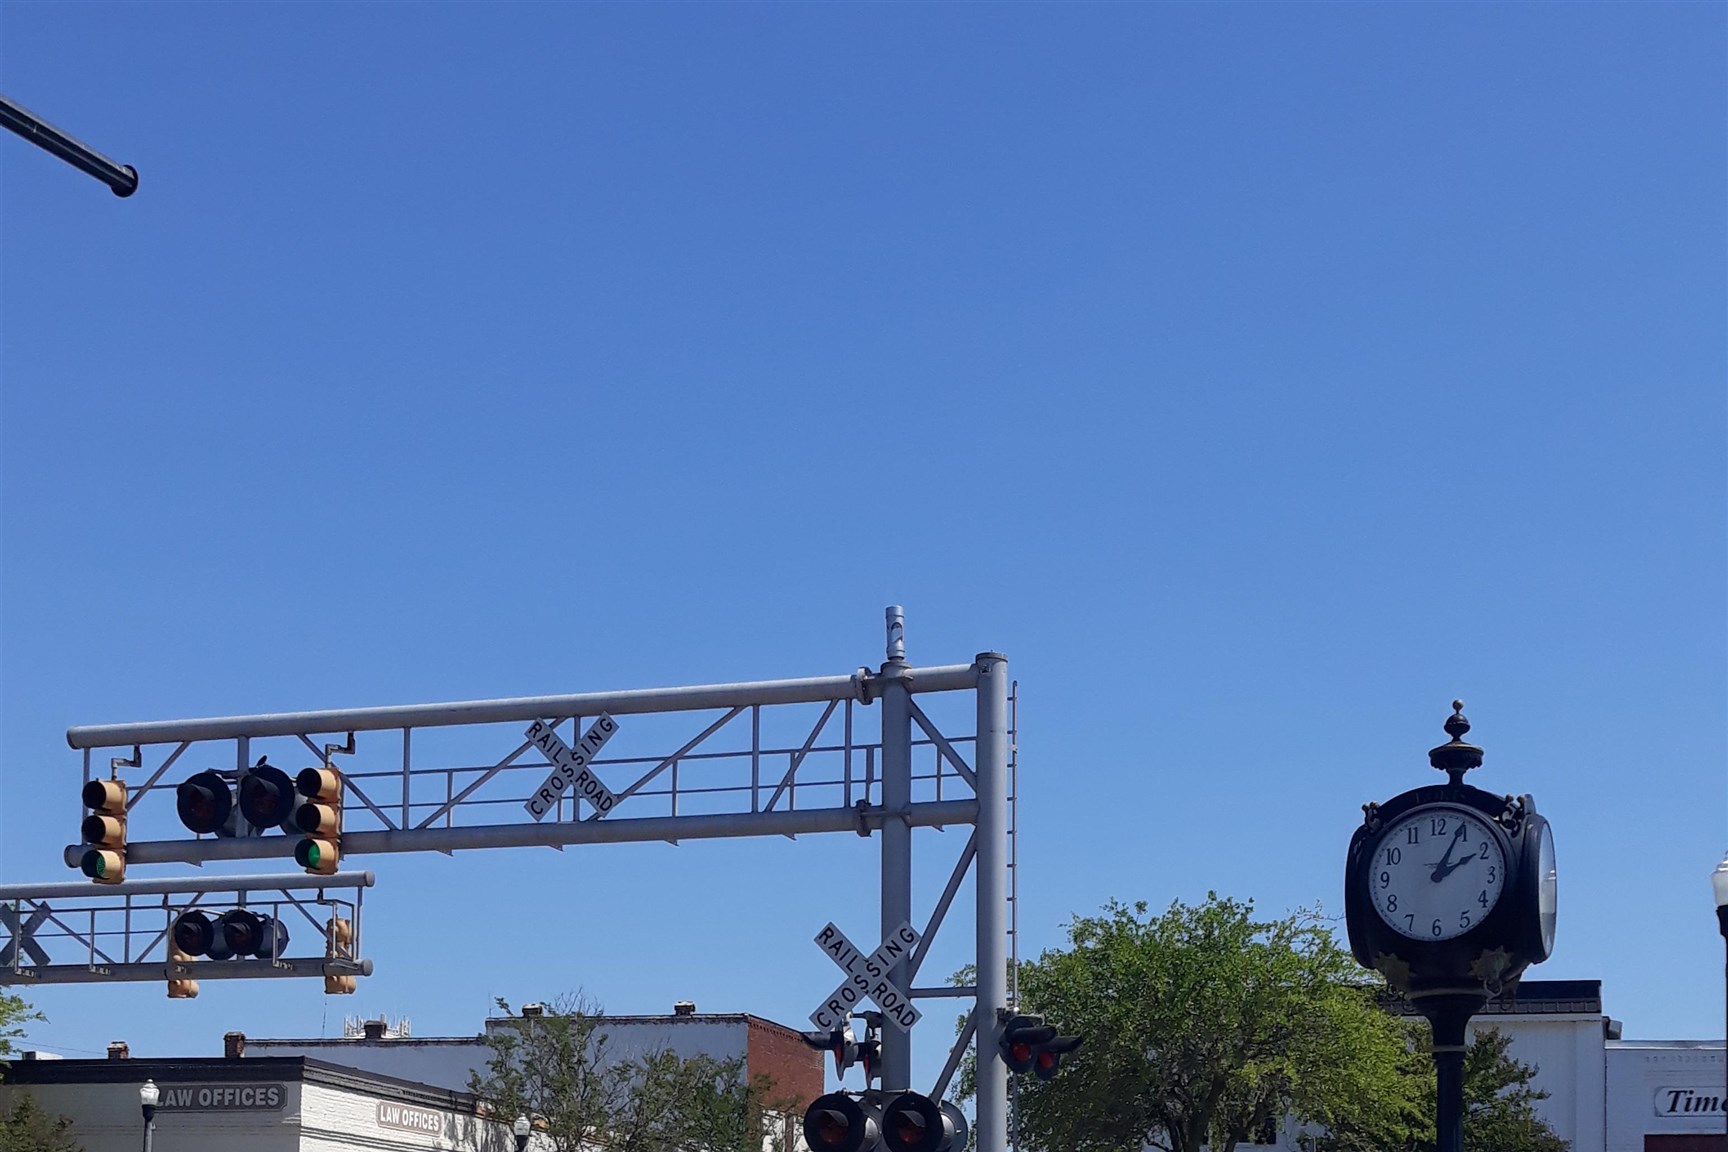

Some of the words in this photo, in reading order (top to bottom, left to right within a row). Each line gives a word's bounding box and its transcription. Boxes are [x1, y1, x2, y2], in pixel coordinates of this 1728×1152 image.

[530, 718, 613, 815] CROSSING
[1406, 827, 1420, 844] 11
[1430, 818, 1447, 836] 12
[1385, 847, 1401, 866] 10
[1479, 842, 1489, 860] 2
[1380, 871, 1390, 889] 9
[1487, 866, 1496, 884] 3
[1386, 894, 1398, 913] 8
[1478, 890, 1489, 909] 4
[1403, 914, 1415, 932] 7
[1432, 919, 1442, 937] 6
[1459, 910, 1471, 929] 5
[816, 928, 915, 1028] CROSSING
[198, 1087, 280, 1107] OFFICES
[380, 1104, 401, 1125] LAW
[402, 1107, 440, 1132] OFFICES
